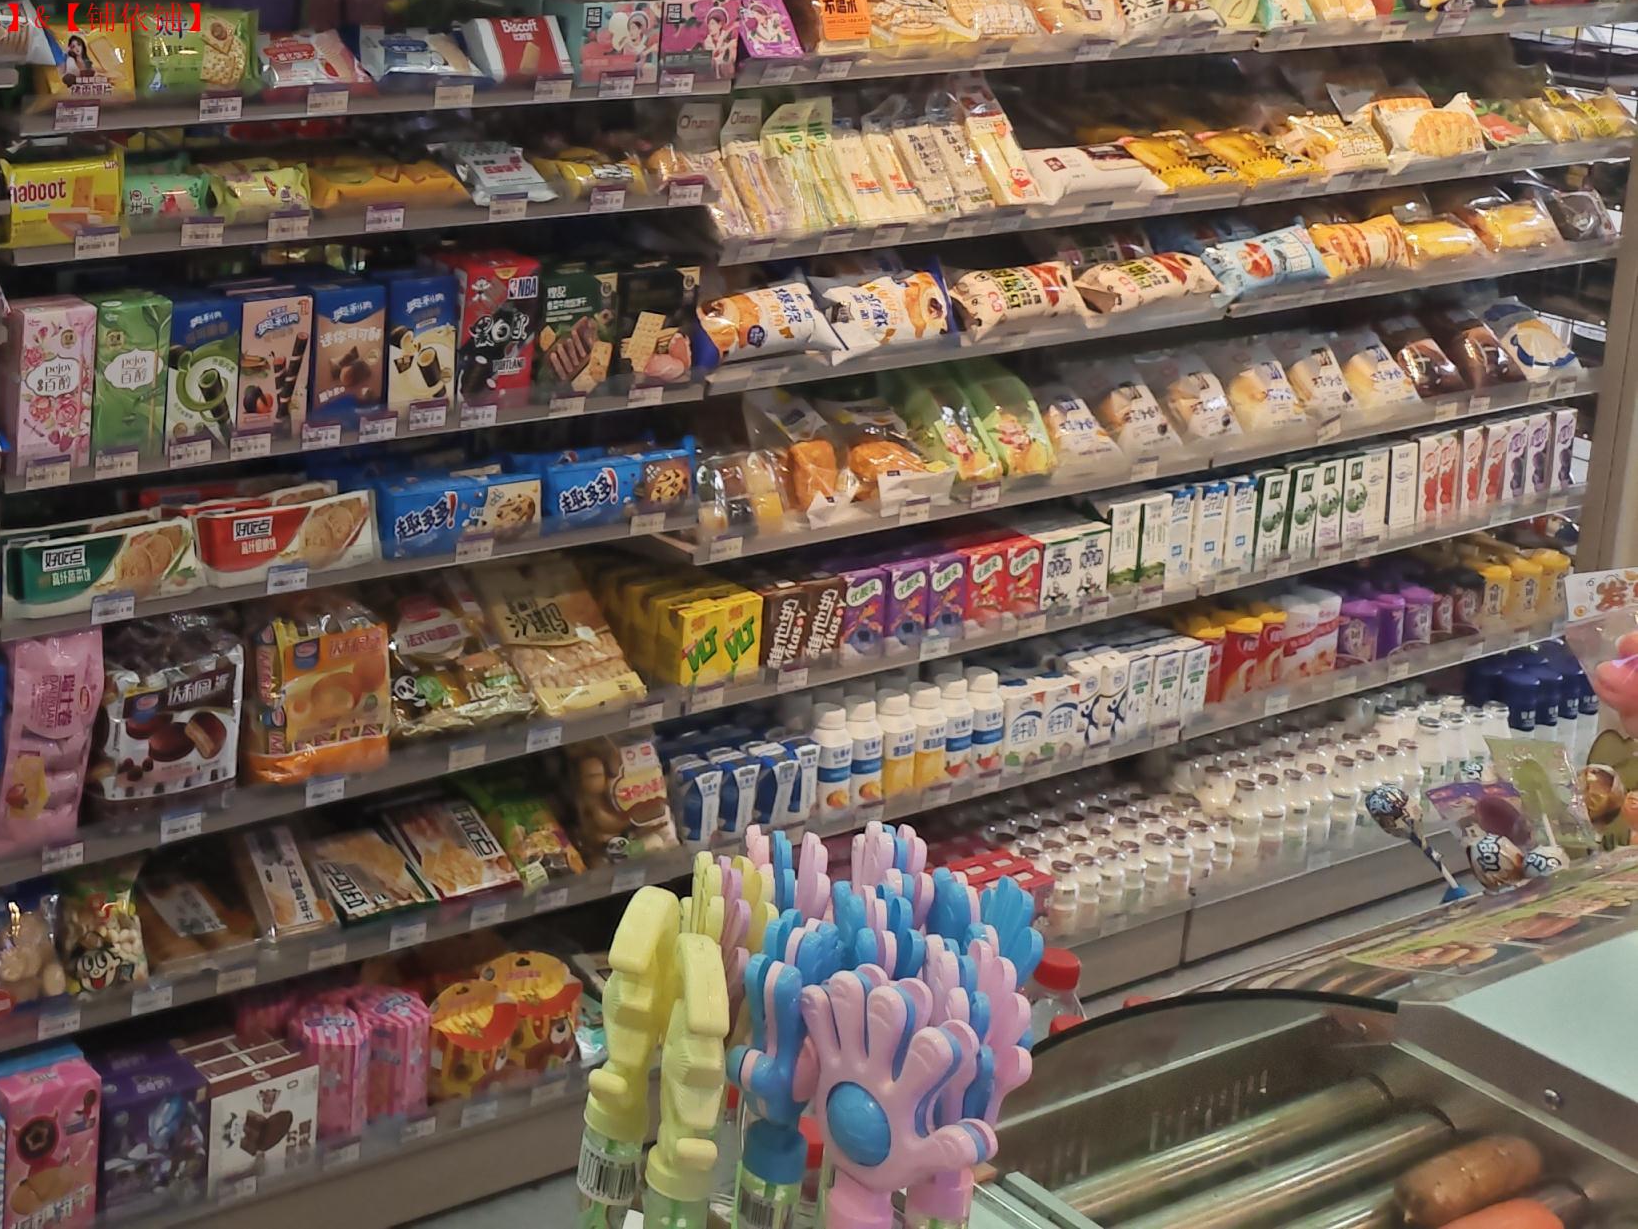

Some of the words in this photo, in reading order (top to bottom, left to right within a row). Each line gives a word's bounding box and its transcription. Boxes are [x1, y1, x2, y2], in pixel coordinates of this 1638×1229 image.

[500, 18, 539, 33] Biscoff
[518, 276, 538, 298] NBA
[469, 313, 530, 347] 黑白配
[235, 519, 273, 538] 好吃点
[44, 548, 84, 569] 好吃点
